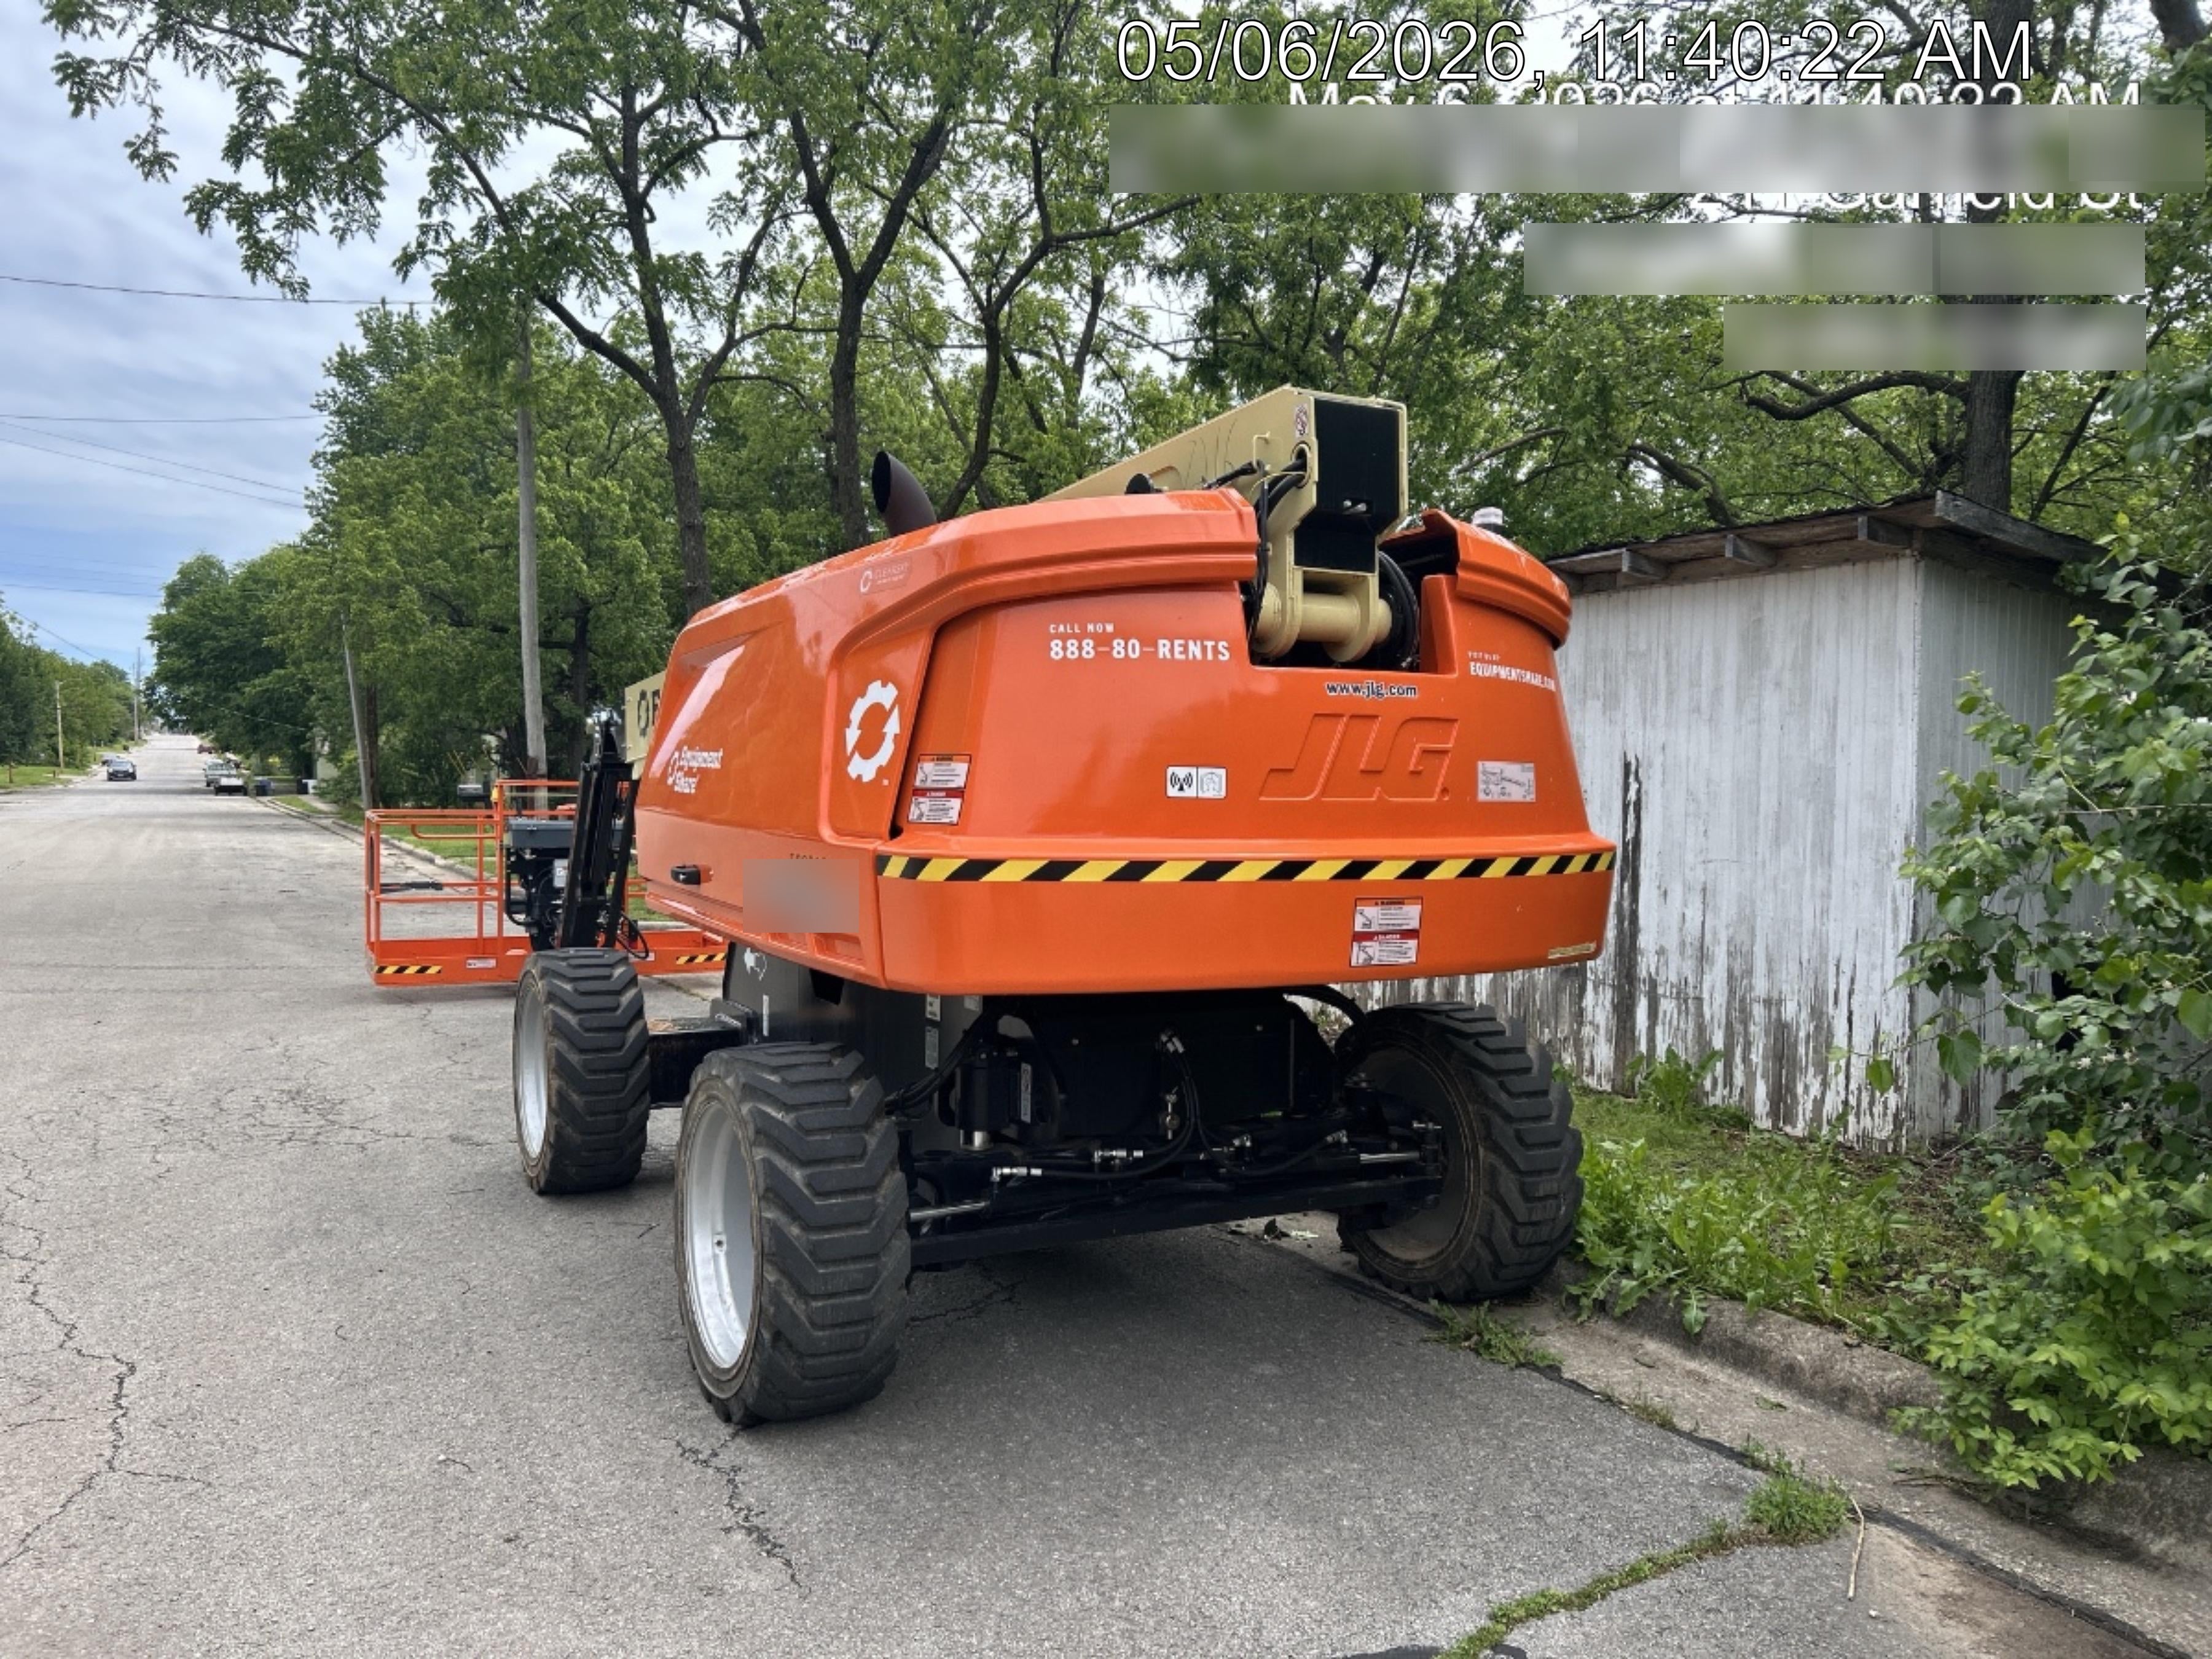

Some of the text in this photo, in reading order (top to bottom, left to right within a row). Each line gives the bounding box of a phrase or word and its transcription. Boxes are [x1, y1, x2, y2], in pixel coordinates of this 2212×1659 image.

[1049, 623, 1115, 633] CALL NOW
[1049, 638, 1230, 661] 888-80-RENTS
[1325, 680, 1418, 700] www.jlg.com
